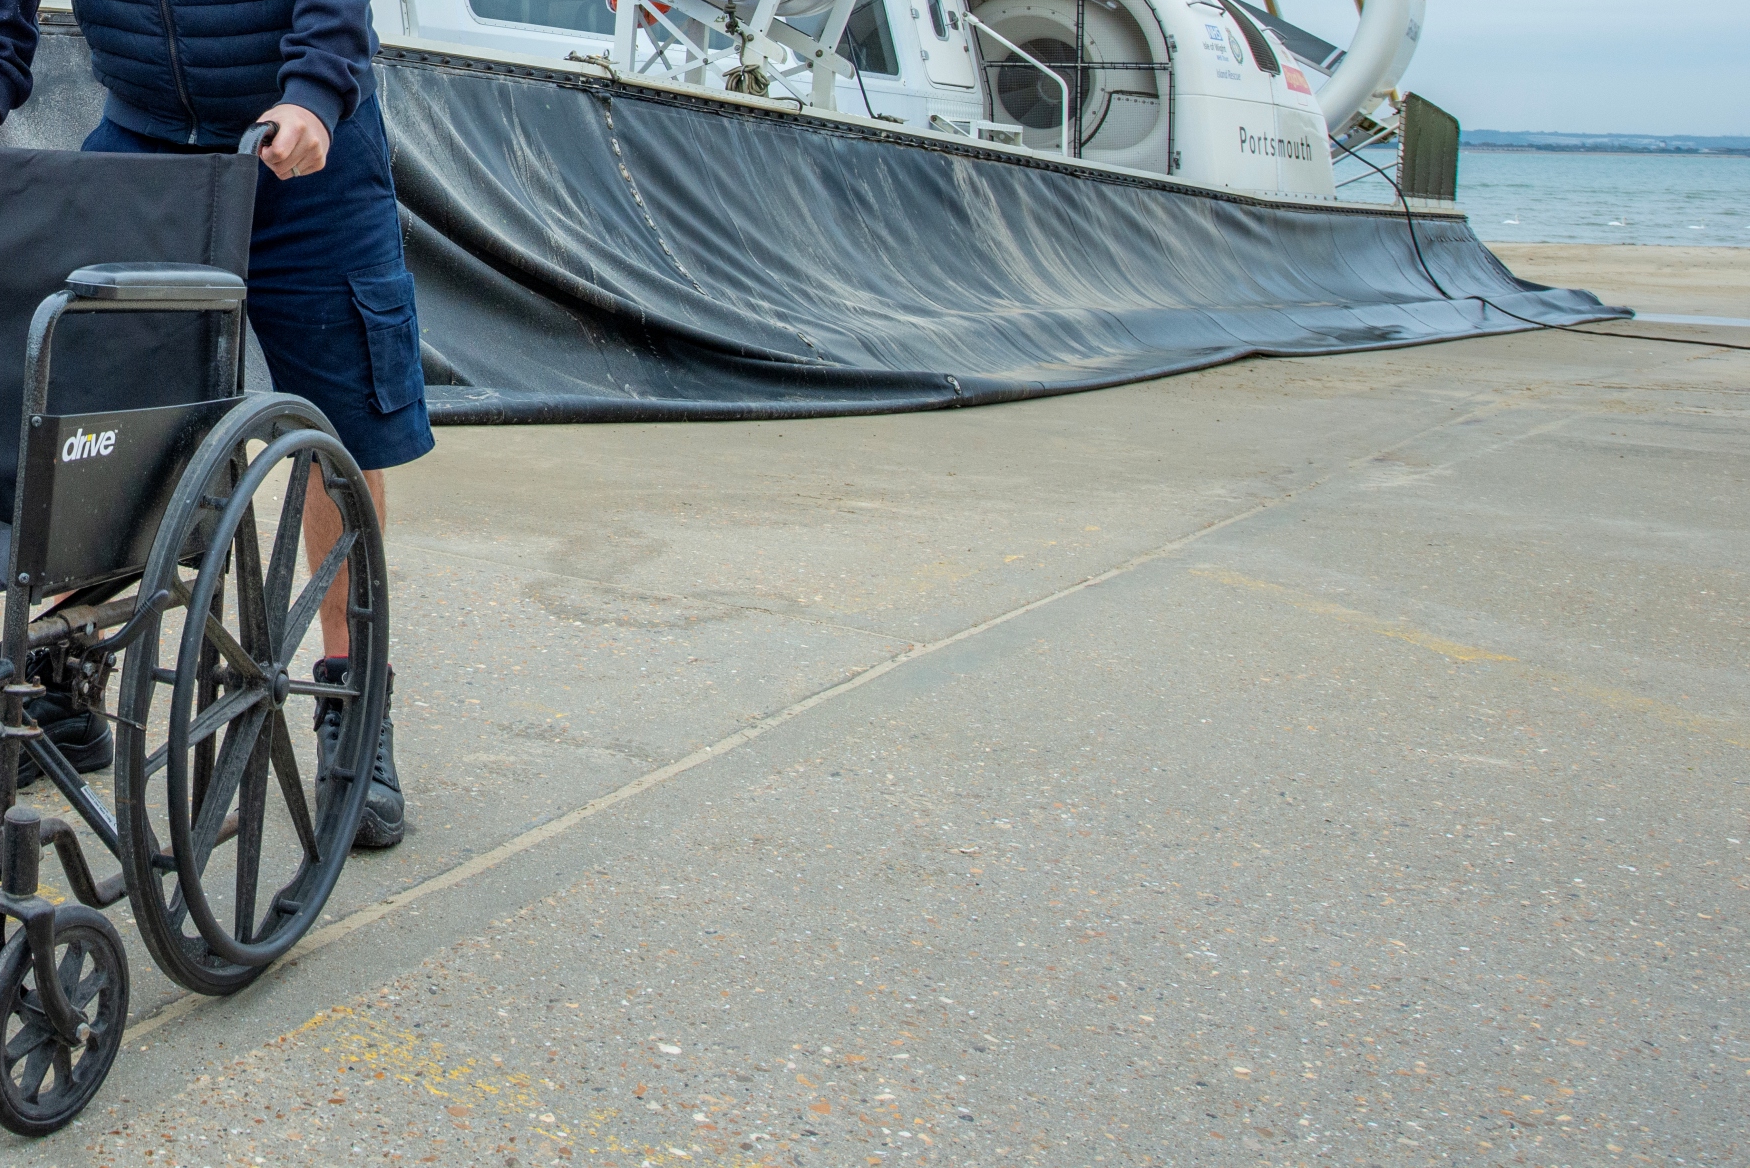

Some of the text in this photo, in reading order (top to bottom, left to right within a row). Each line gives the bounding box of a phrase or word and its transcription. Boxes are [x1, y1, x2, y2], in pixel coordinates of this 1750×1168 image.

[1206, 25, 1222, 40] NHS
[1239, 126, 1313, 161] Portsmouth
[61, 428, 117, 462] drive
